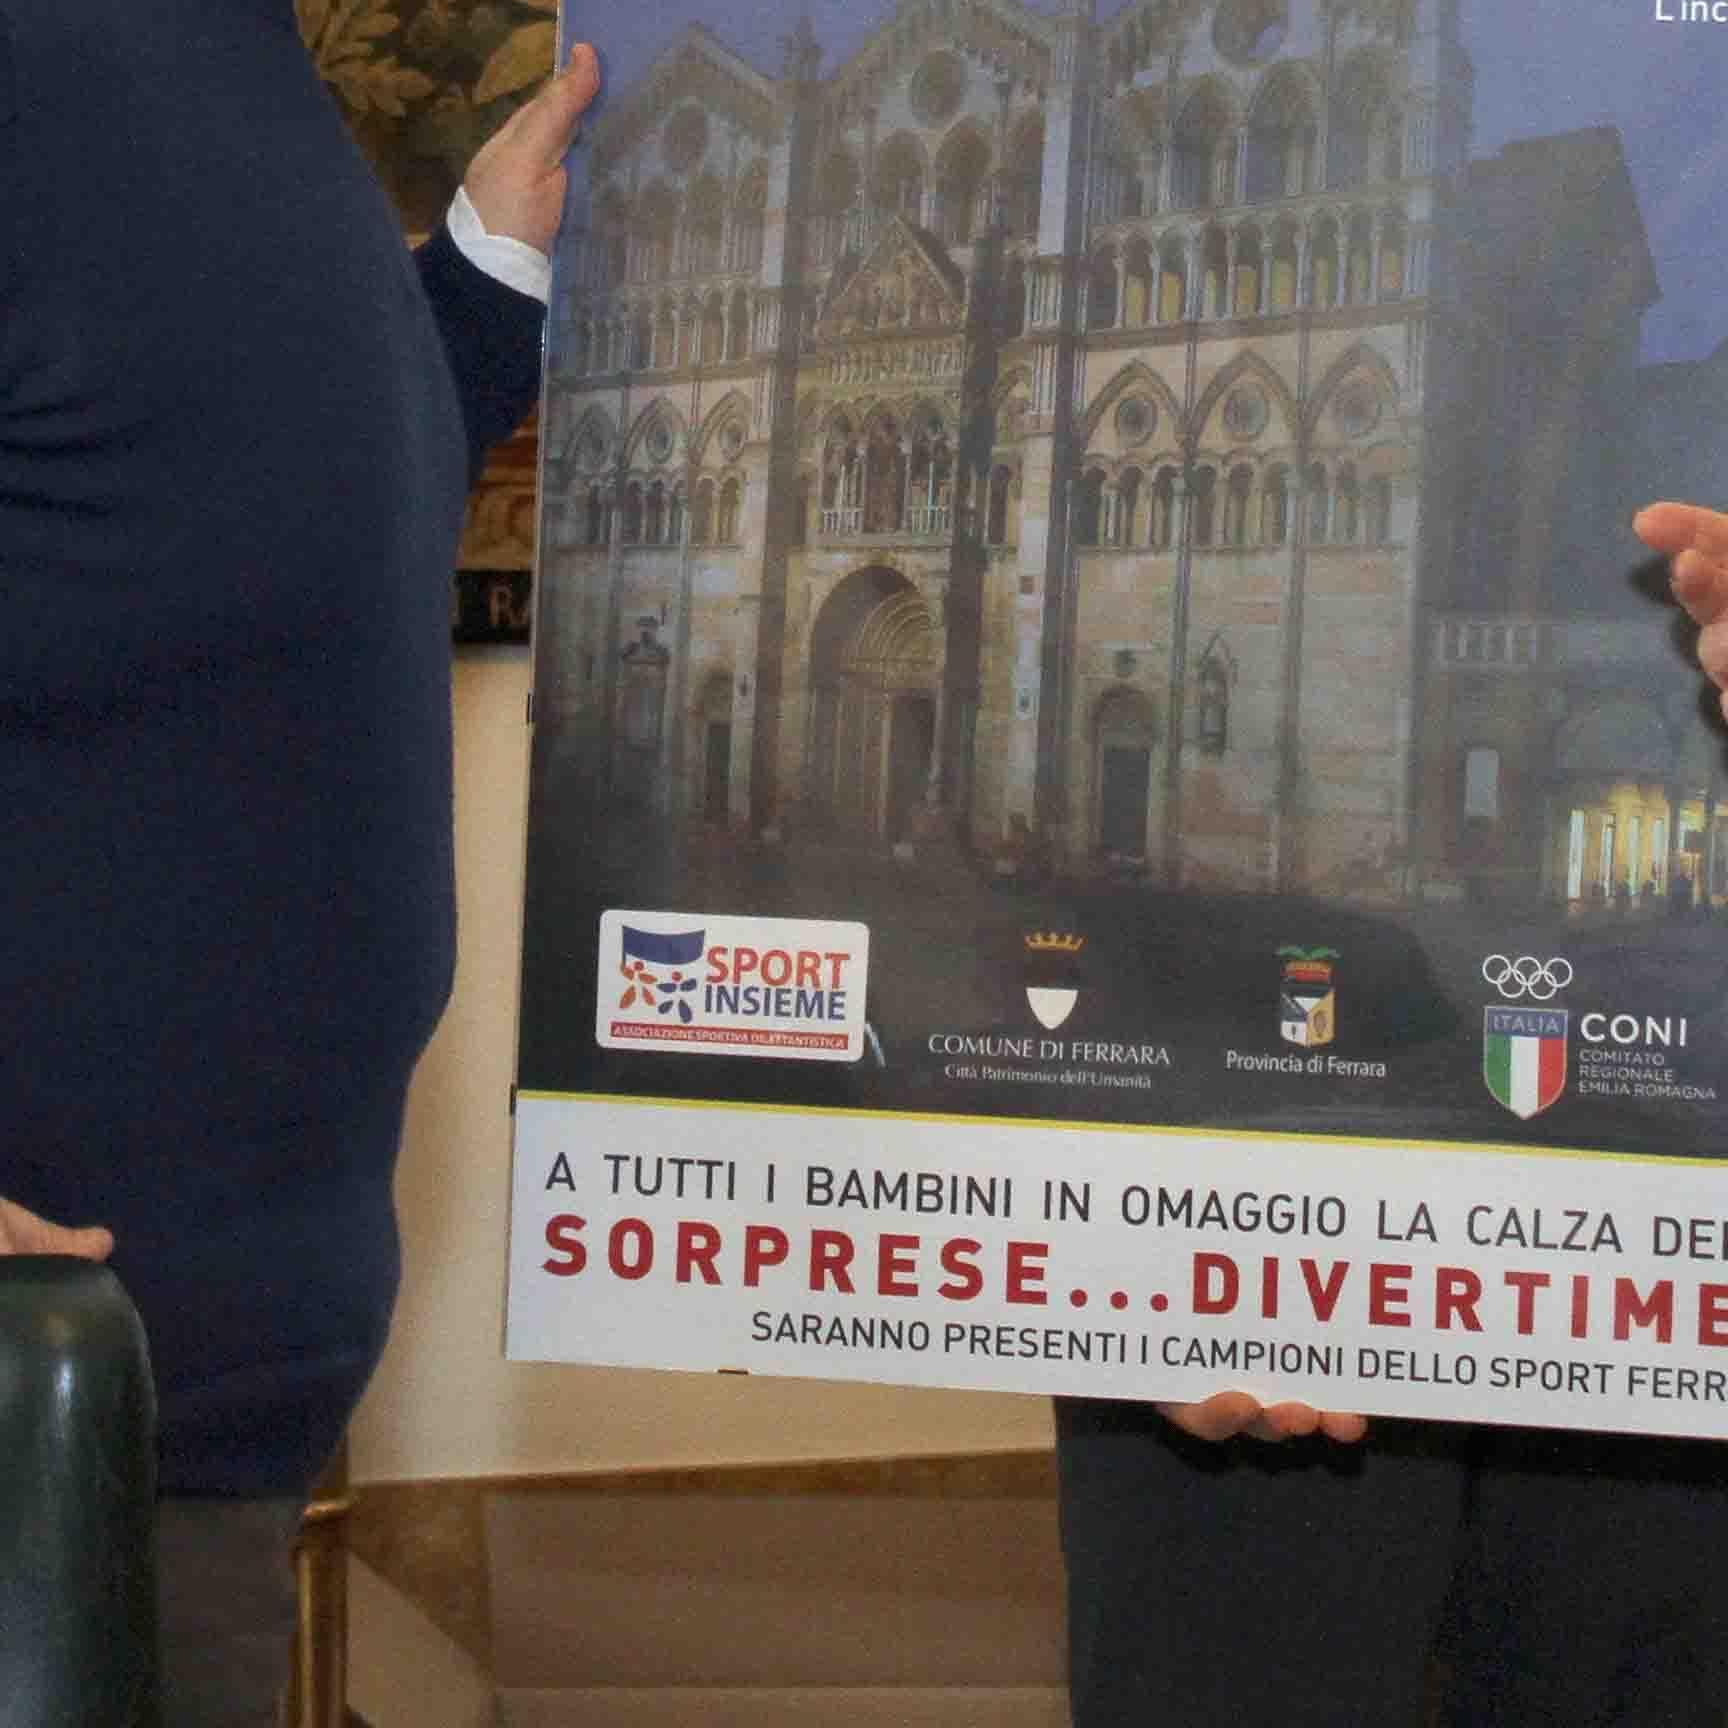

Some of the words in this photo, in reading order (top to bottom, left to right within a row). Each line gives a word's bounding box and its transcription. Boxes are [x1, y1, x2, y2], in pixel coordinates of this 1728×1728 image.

[705, 945, 850, 990] SPORT
[703, 984, 847, 1021] INSIEME
[1493, 1015, 1560, 1033] ITALIA
[1580, 1012, 1688, 1047] CONI
[928, 1033, 1033, 1058] COMUNE
[1040, 1040, 1064, 1060] DI
[1071, 1040, 1171, 1065] FERRARA
[1226, 1049, 1303, 1073] Provincia
[1307, 1054, 1323, 1073] di
[1327, 1055, 1386, 1078] Ferrara
[1578, 1049, 1665, 1066] COMITATO
[944, 1063, 977, 1080] Città
[982, 1065, 1057, 1084] Patrimonio
[1578, 1065, 1673, 1083] REGIONALE
[1578, 1080, 1630, 1096] EMILIA
[1634, 1084, 1717, 1100] ROMAGNA
[546, 1152, 576, 1192] A
[603, 1153, 737, 1201] TUTTI
[765, 1164, 775, 1204] I
[806, 1167, 1013, 1218] BAMBINI
[1044, 1181, 1091, 1223] IN
[1121, 1185, 1346, 1238] OMAGGIO
[1377, 1200, 1438, 1243] LA
[1467, 1205, 1624, 1255] CALZA
[752, 1311, 931, 1352] SARANNO
[944, 1324, 1127, 1365] PRESENTI
[1139, 1334, 1149, 1366] I
[1162, 1336, 1344, 1377] CAMPIONI
[1357, 1347, 1477, 1386] DELLO
[1490, 1358, 1614, 1396] SPORT
